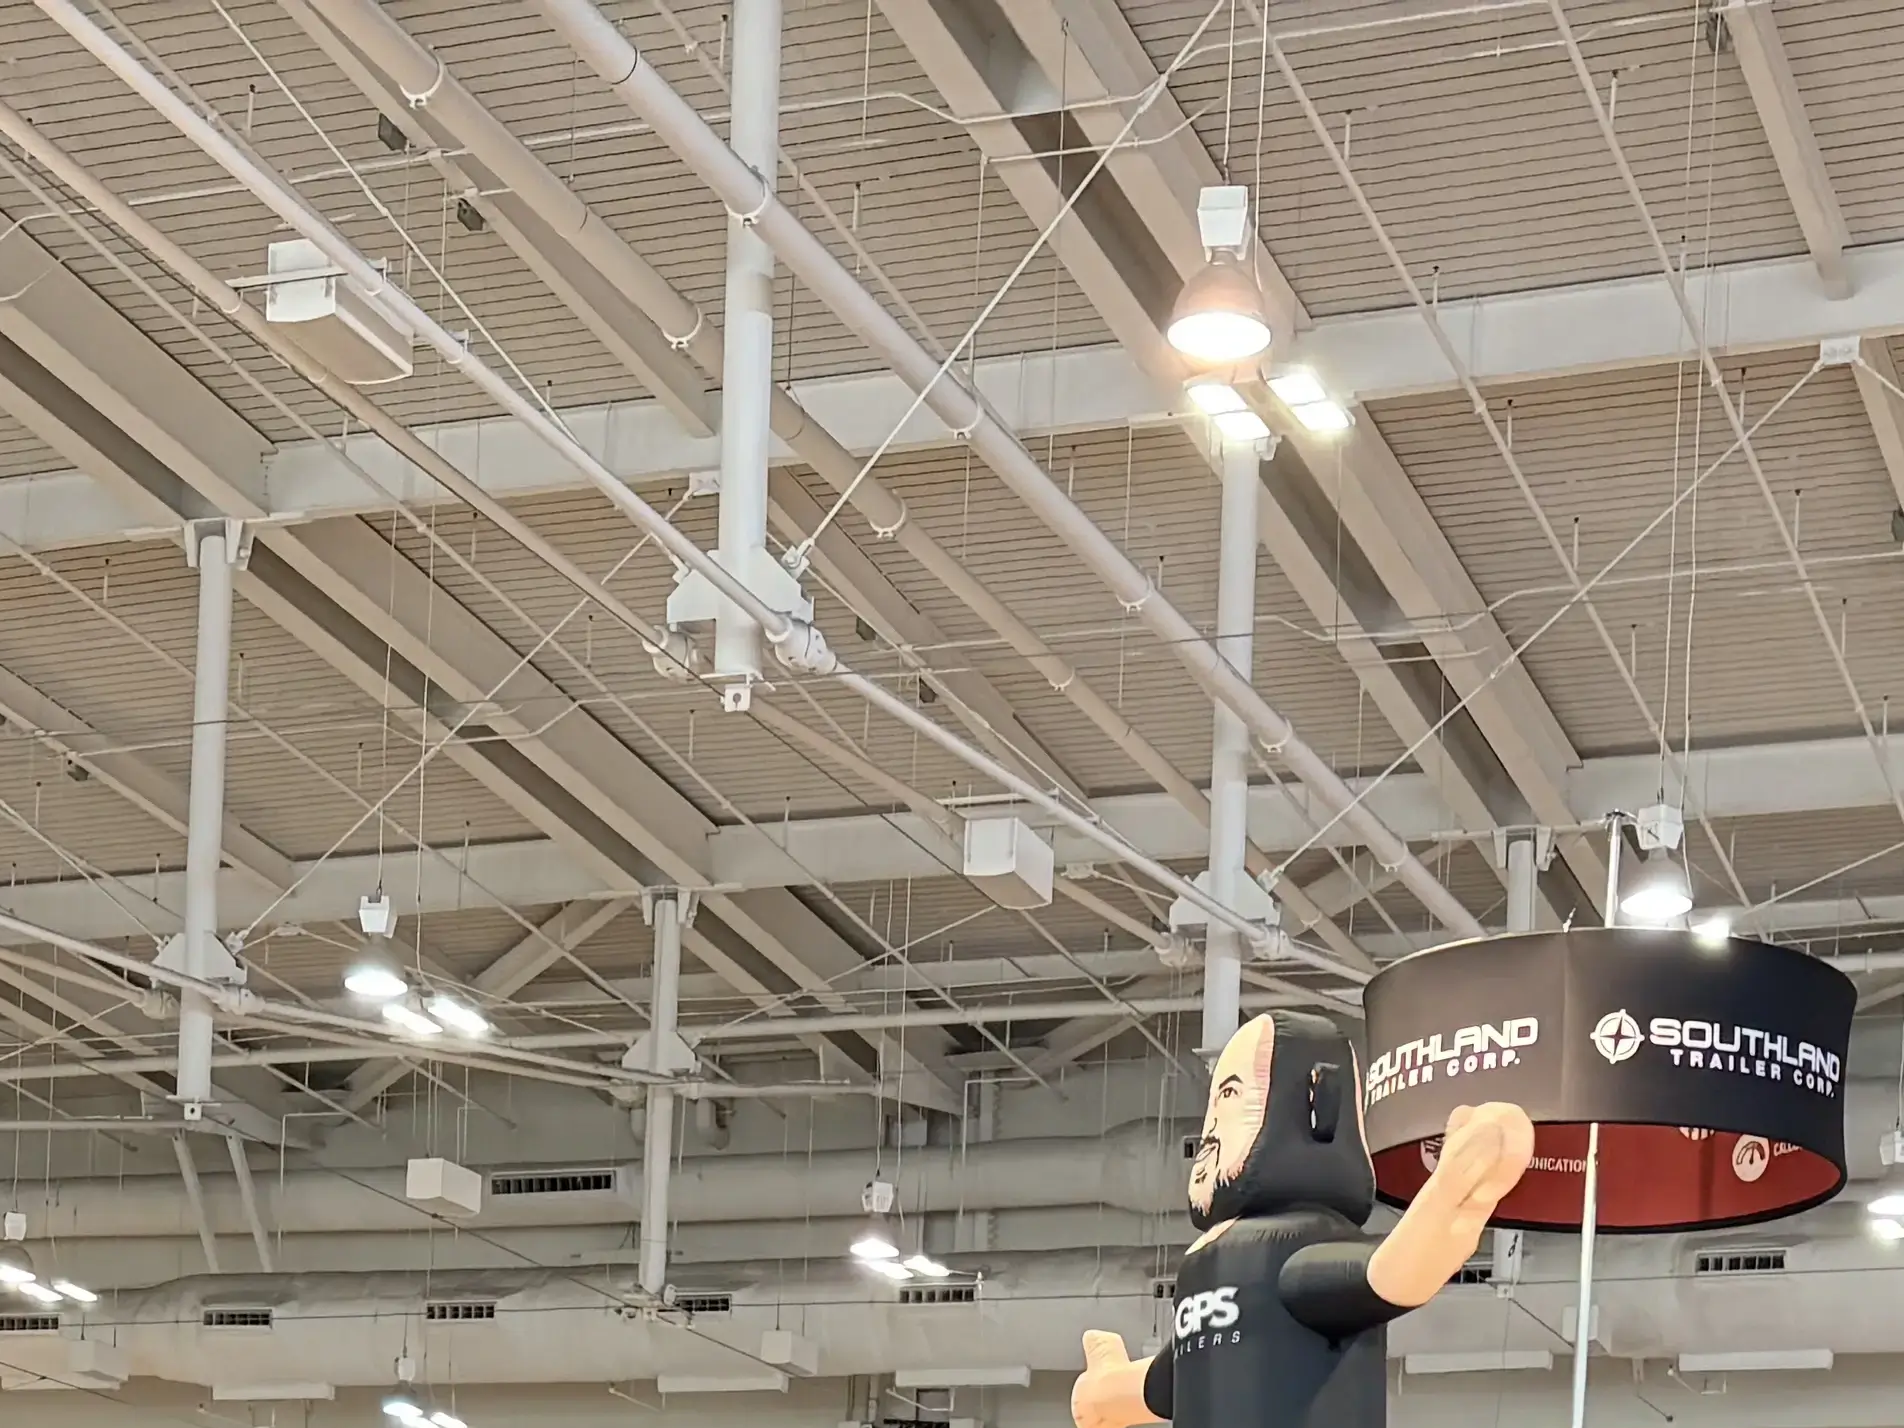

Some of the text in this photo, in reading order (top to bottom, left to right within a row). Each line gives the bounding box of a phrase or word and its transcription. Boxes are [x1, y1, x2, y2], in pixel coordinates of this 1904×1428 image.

[1368, 1017, 1538, 1090] SOUTHLAND
[1370, 1050, 1521, 1105] TRAILER CORP.
[1649, 1017, 1840, 1083] SOUTHLAND
[1670, 1048, 1836, 1098] TRAILER CORP.
[1175, 1286, 1239, 1340] GPS
